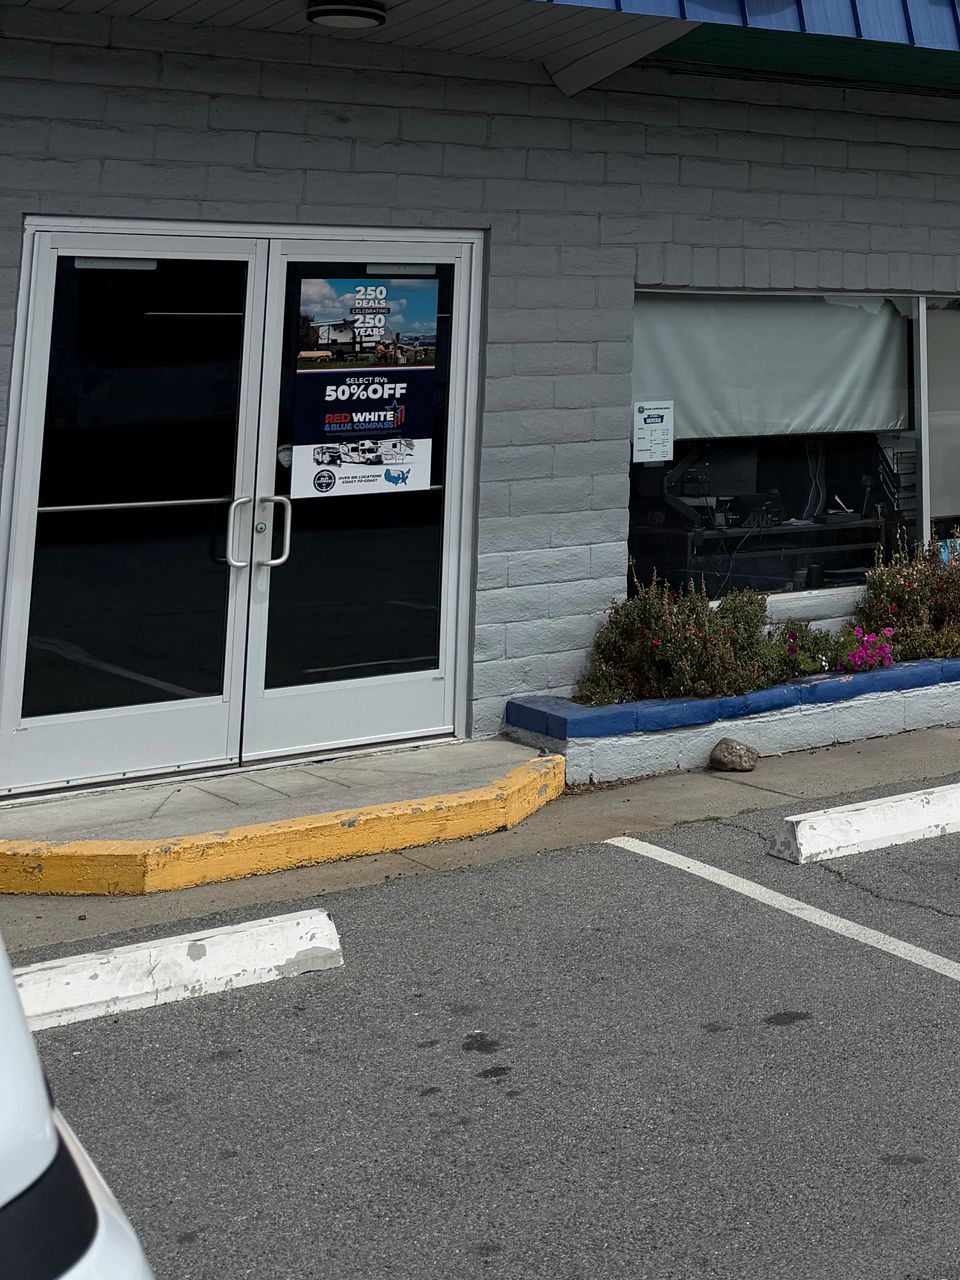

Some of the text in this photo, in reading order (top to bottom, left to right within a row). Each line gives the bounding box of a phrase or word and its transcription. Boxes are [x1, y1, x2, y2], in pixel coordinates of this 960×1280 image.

[355, 286, 387, 299] 250
[355, 299, 386, 307] DEALS
[353, 314, 386, 328] 250
[353, 327, 385, 336] YEARS
[324, 383, 407, 401] 50%OFF
[325, 411, 394, 423] RED WHITE
[353, 421, 394, 430] COMPASS
